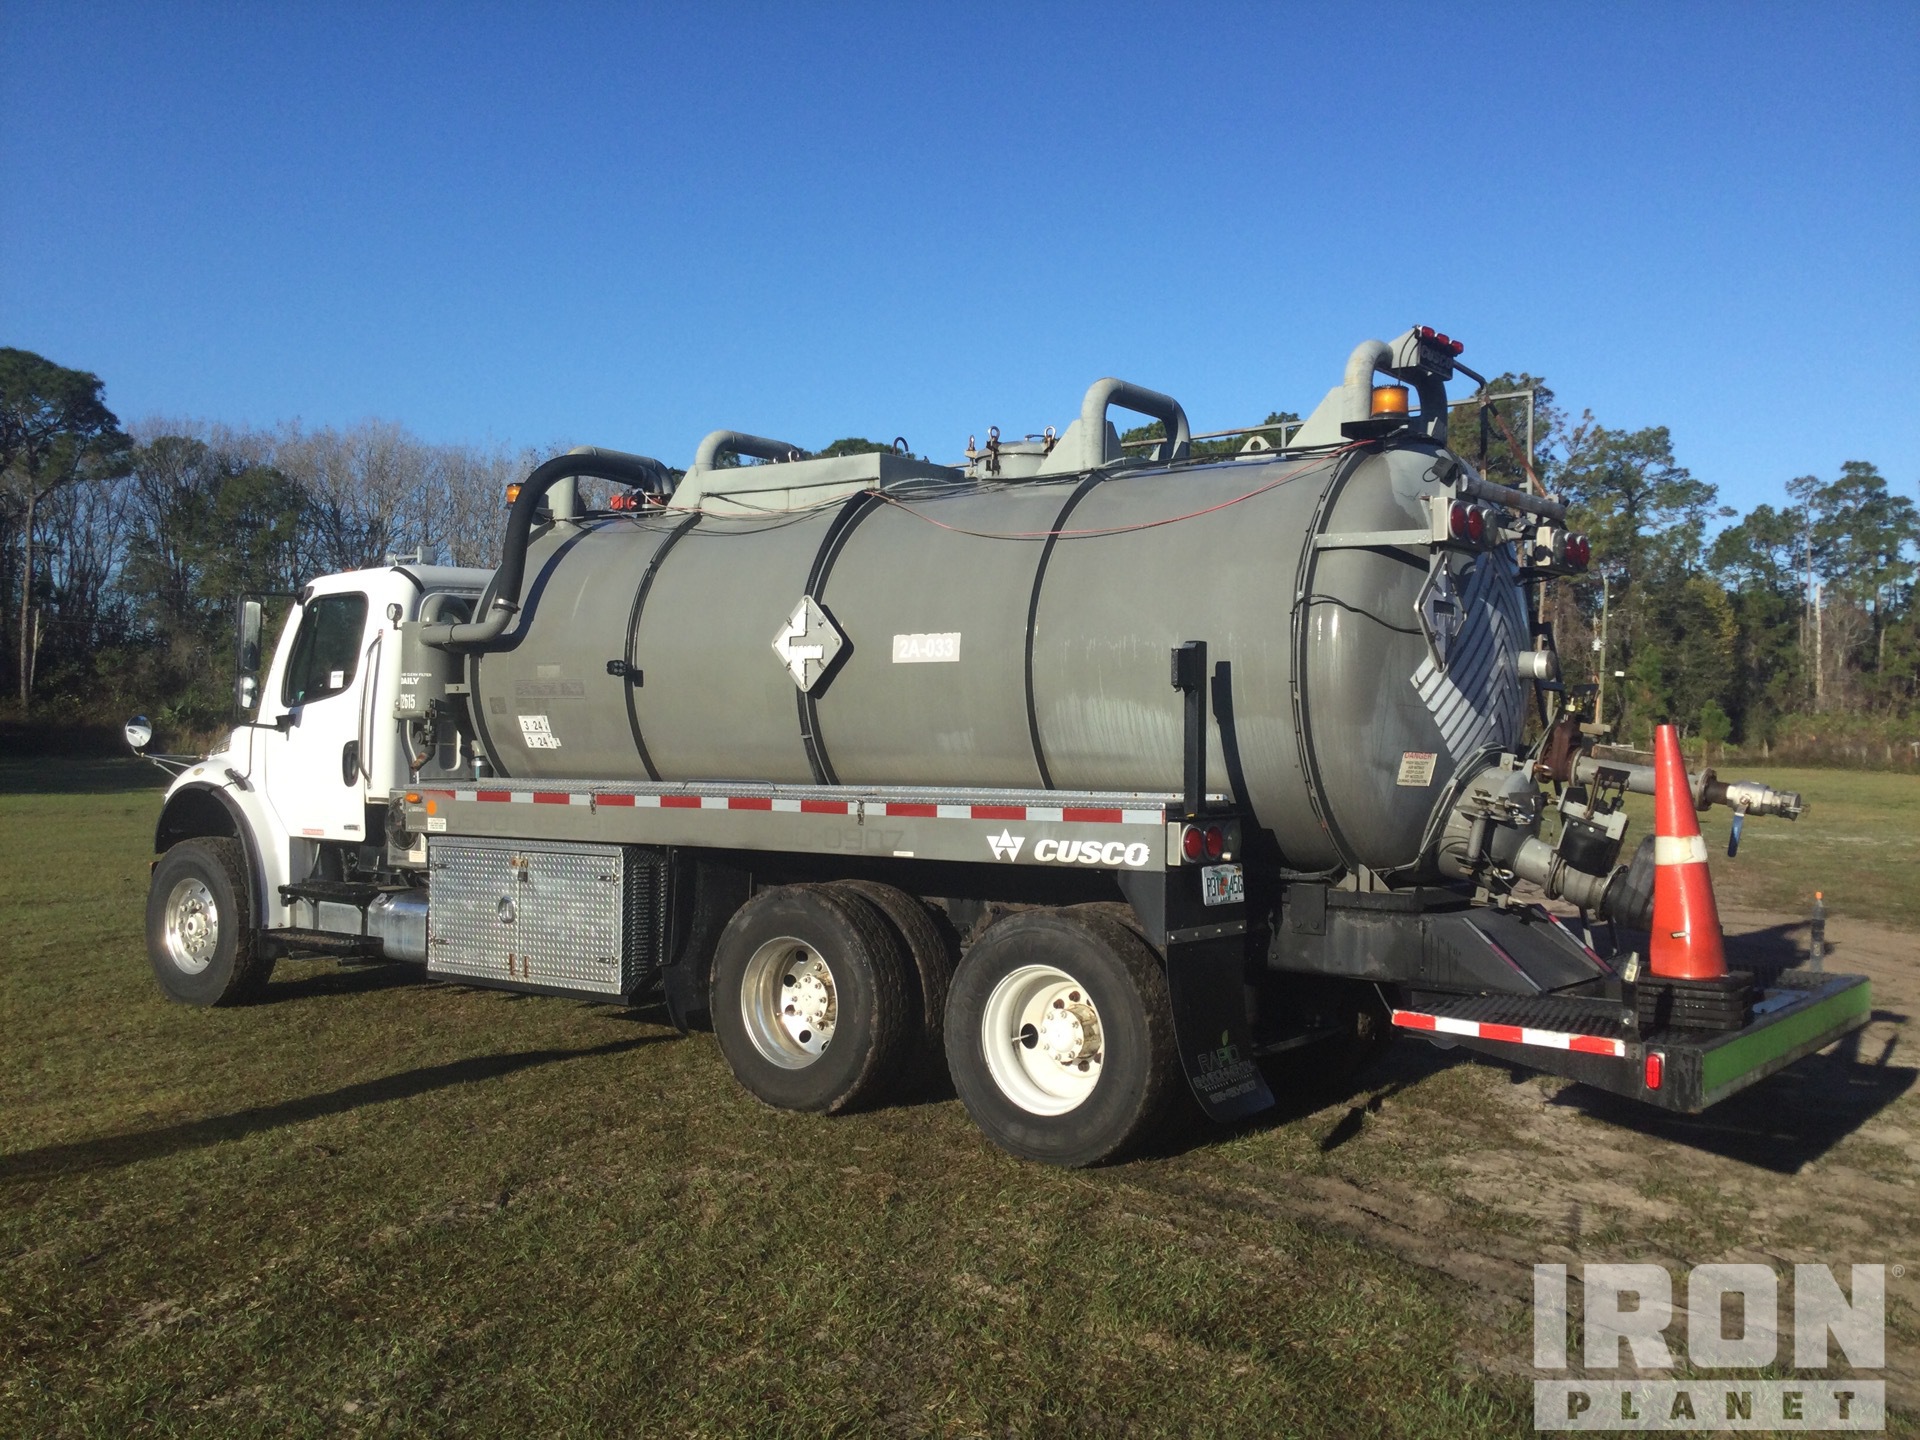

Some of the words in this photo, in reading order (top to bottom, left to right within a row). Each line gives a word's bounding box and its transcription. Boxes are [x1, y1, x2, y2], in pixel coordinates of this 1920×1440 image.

[898, 638, 954, 658] 2A-033
[523, 720, 530, 731] 3
[532, 720, 543, 731] 24
[528, 736, 535, 747] 3
[537, 737, 549, 747] 24
[1404, 752, 1432, 760] DANGER
[1034, 839, 1150, 867] CUSCO
